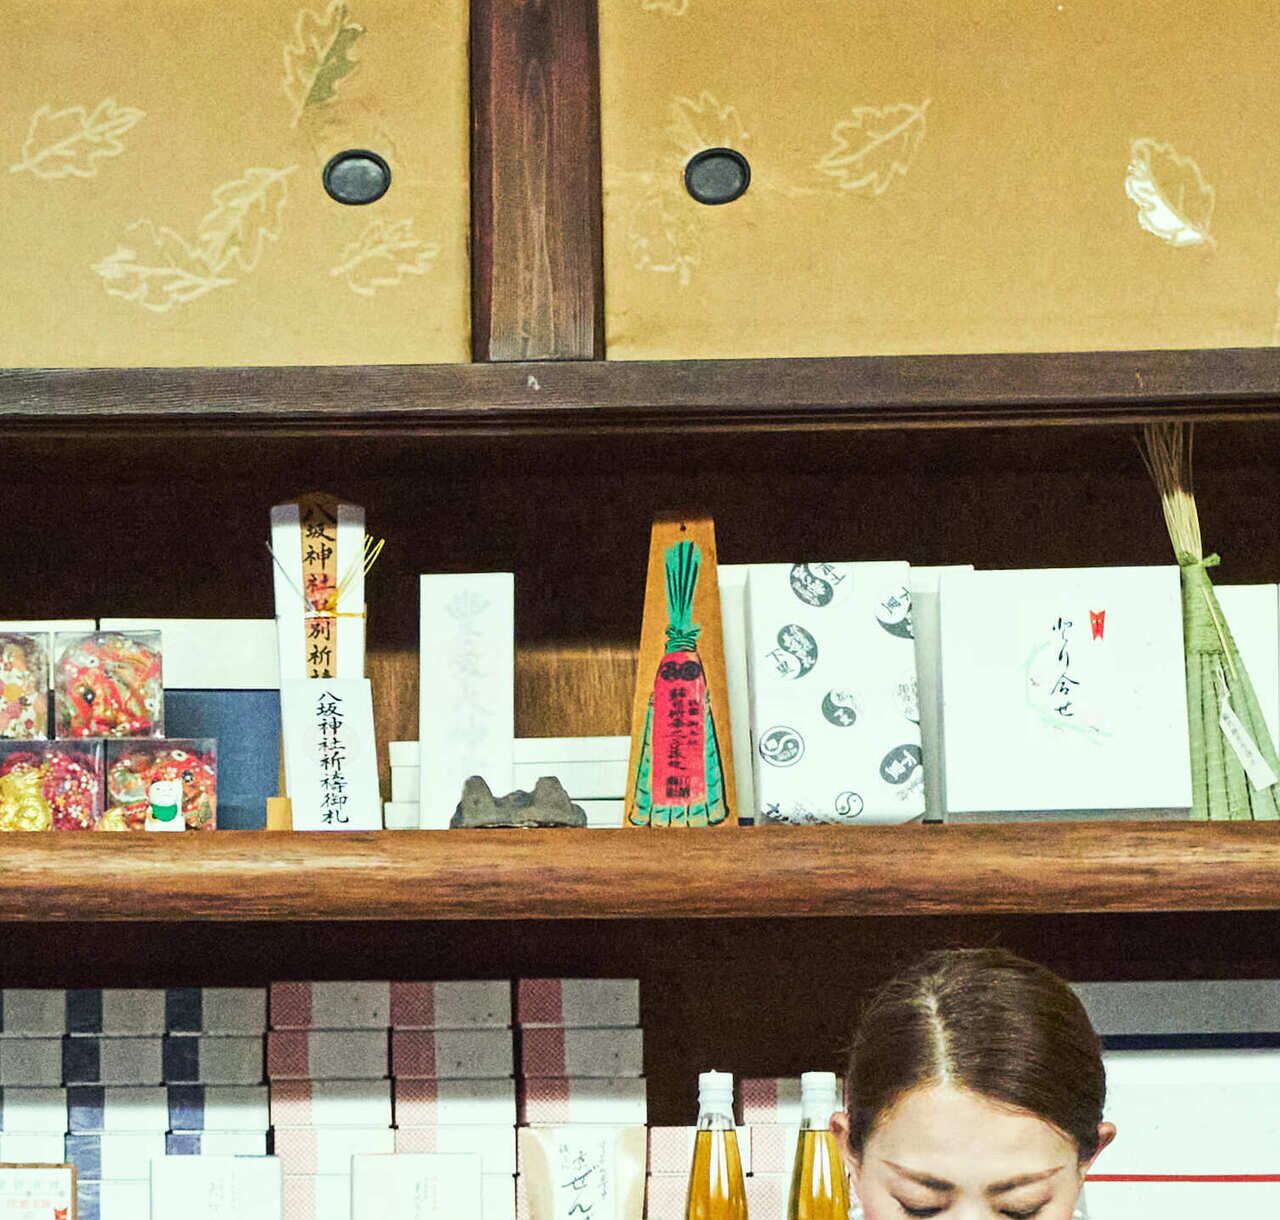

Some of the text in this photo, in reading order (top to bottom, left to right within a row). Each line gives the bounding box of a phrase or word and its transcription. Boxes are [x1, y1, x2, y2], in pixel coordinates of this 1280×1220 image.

[303, 507, 338, 678] 八坂神社別祈
